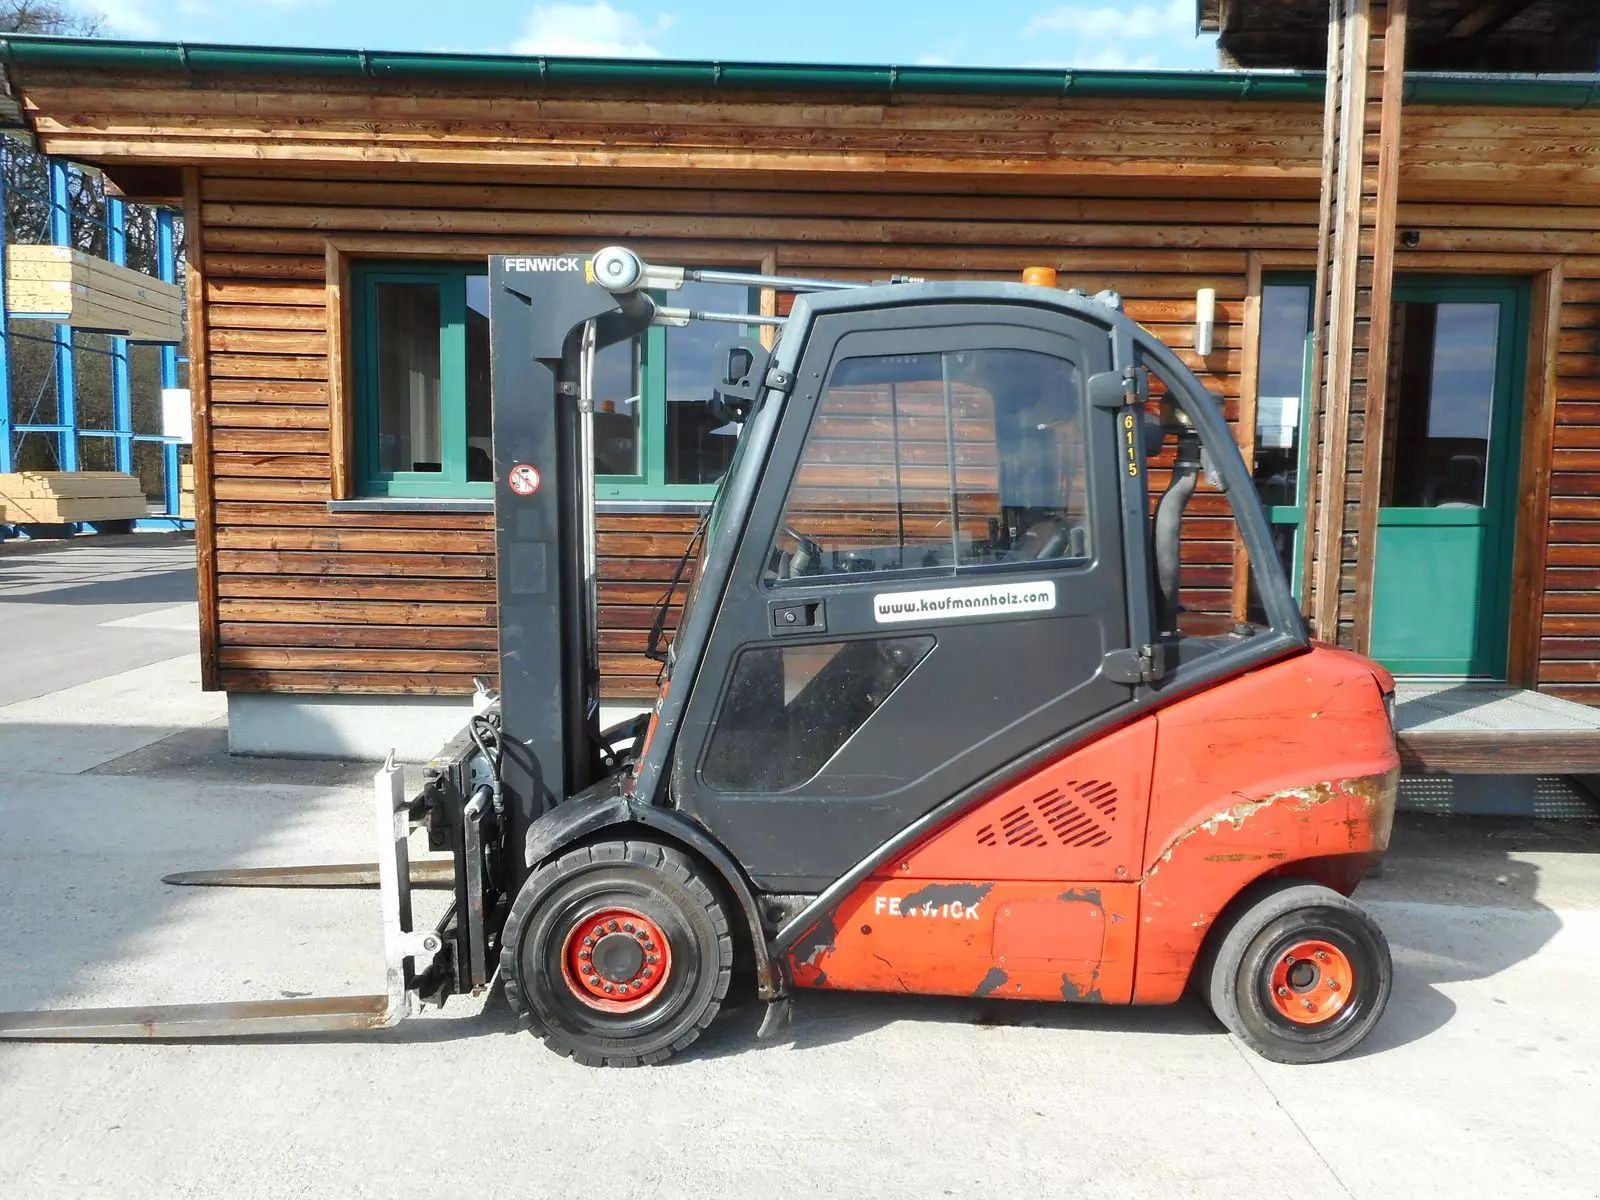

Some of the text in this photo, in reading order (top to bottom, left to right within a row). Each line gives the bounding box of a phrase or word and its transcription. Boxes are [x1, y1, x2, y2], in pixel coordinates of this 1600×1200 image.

[505, 257, 579, 272] FENWICK
[1124, 415, 1137, 476] 6115
[879, 592, 1049, 615] www.kaufmannholz.com
[875, 896, 981, 920] FEWICK
